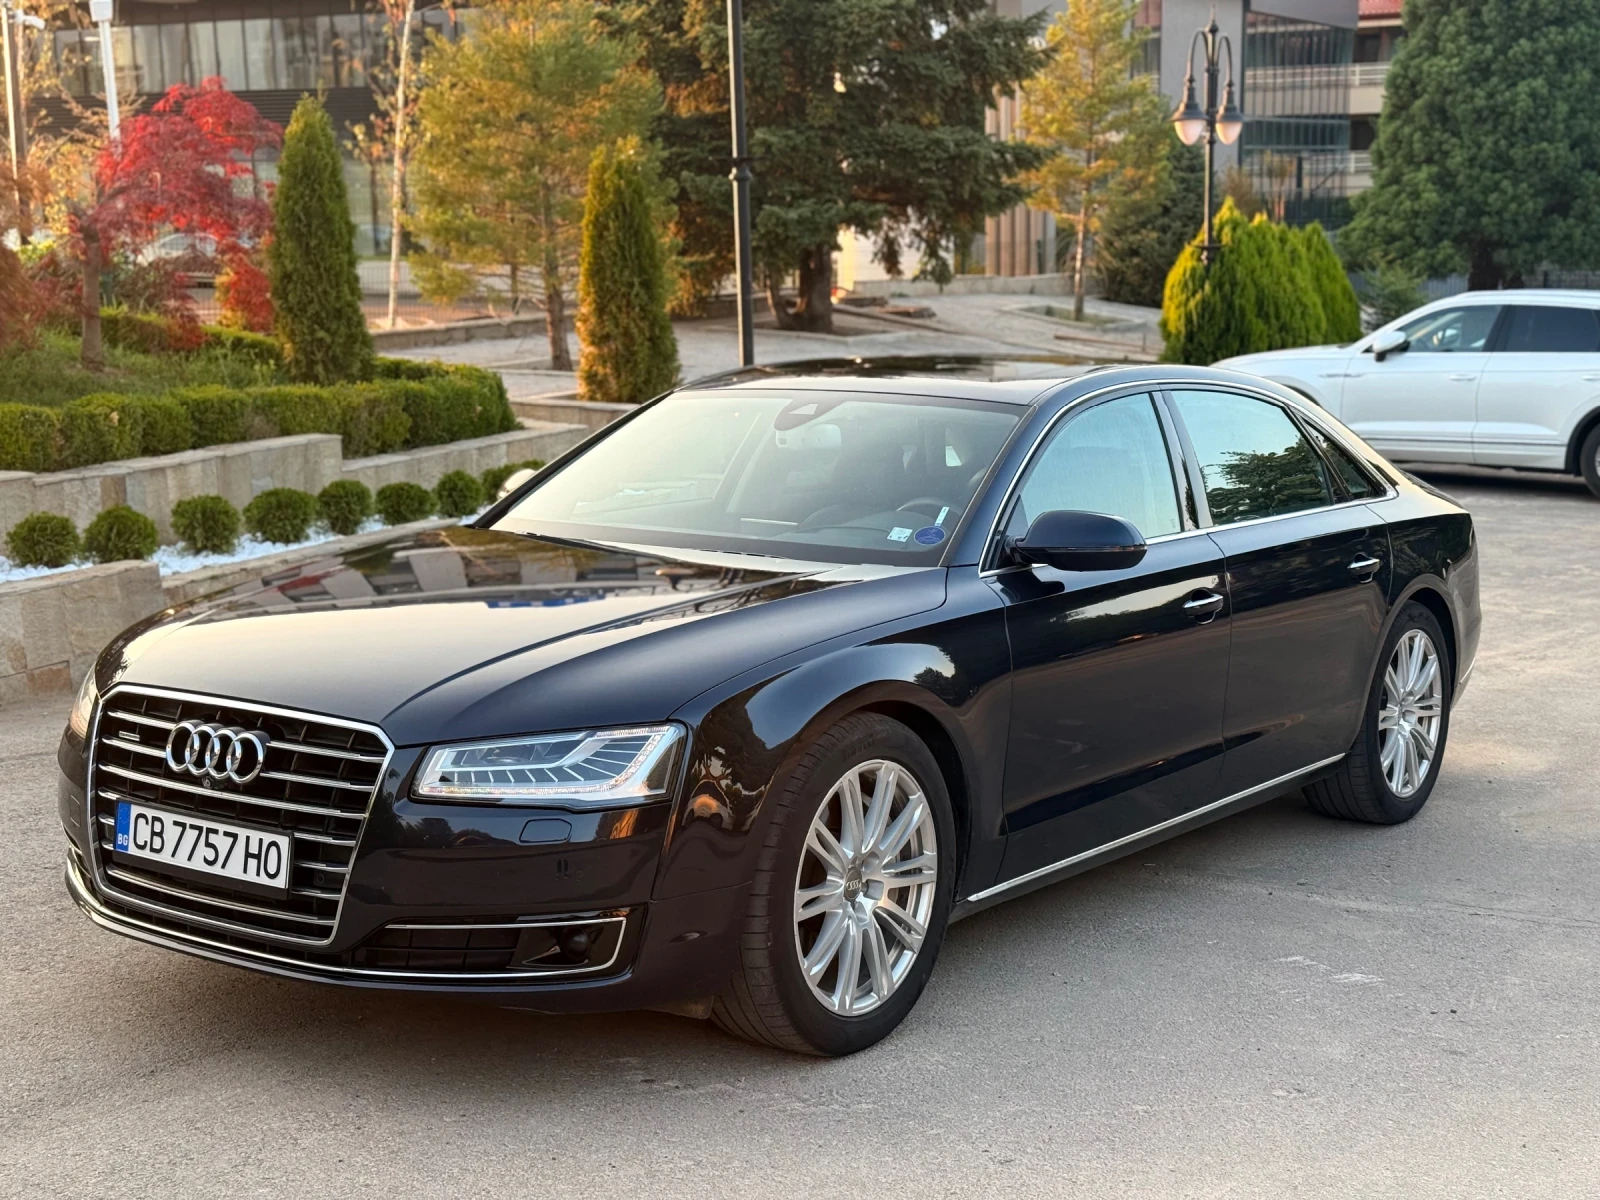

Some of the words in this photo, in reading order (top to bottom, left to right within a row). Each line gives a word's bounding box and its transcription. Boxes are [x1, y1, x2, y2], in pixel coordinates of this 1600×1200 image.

[117, 833, 129, 846] BG
[133, 812, 165, 854] CB
[171, 820, 239, 870] 7757
